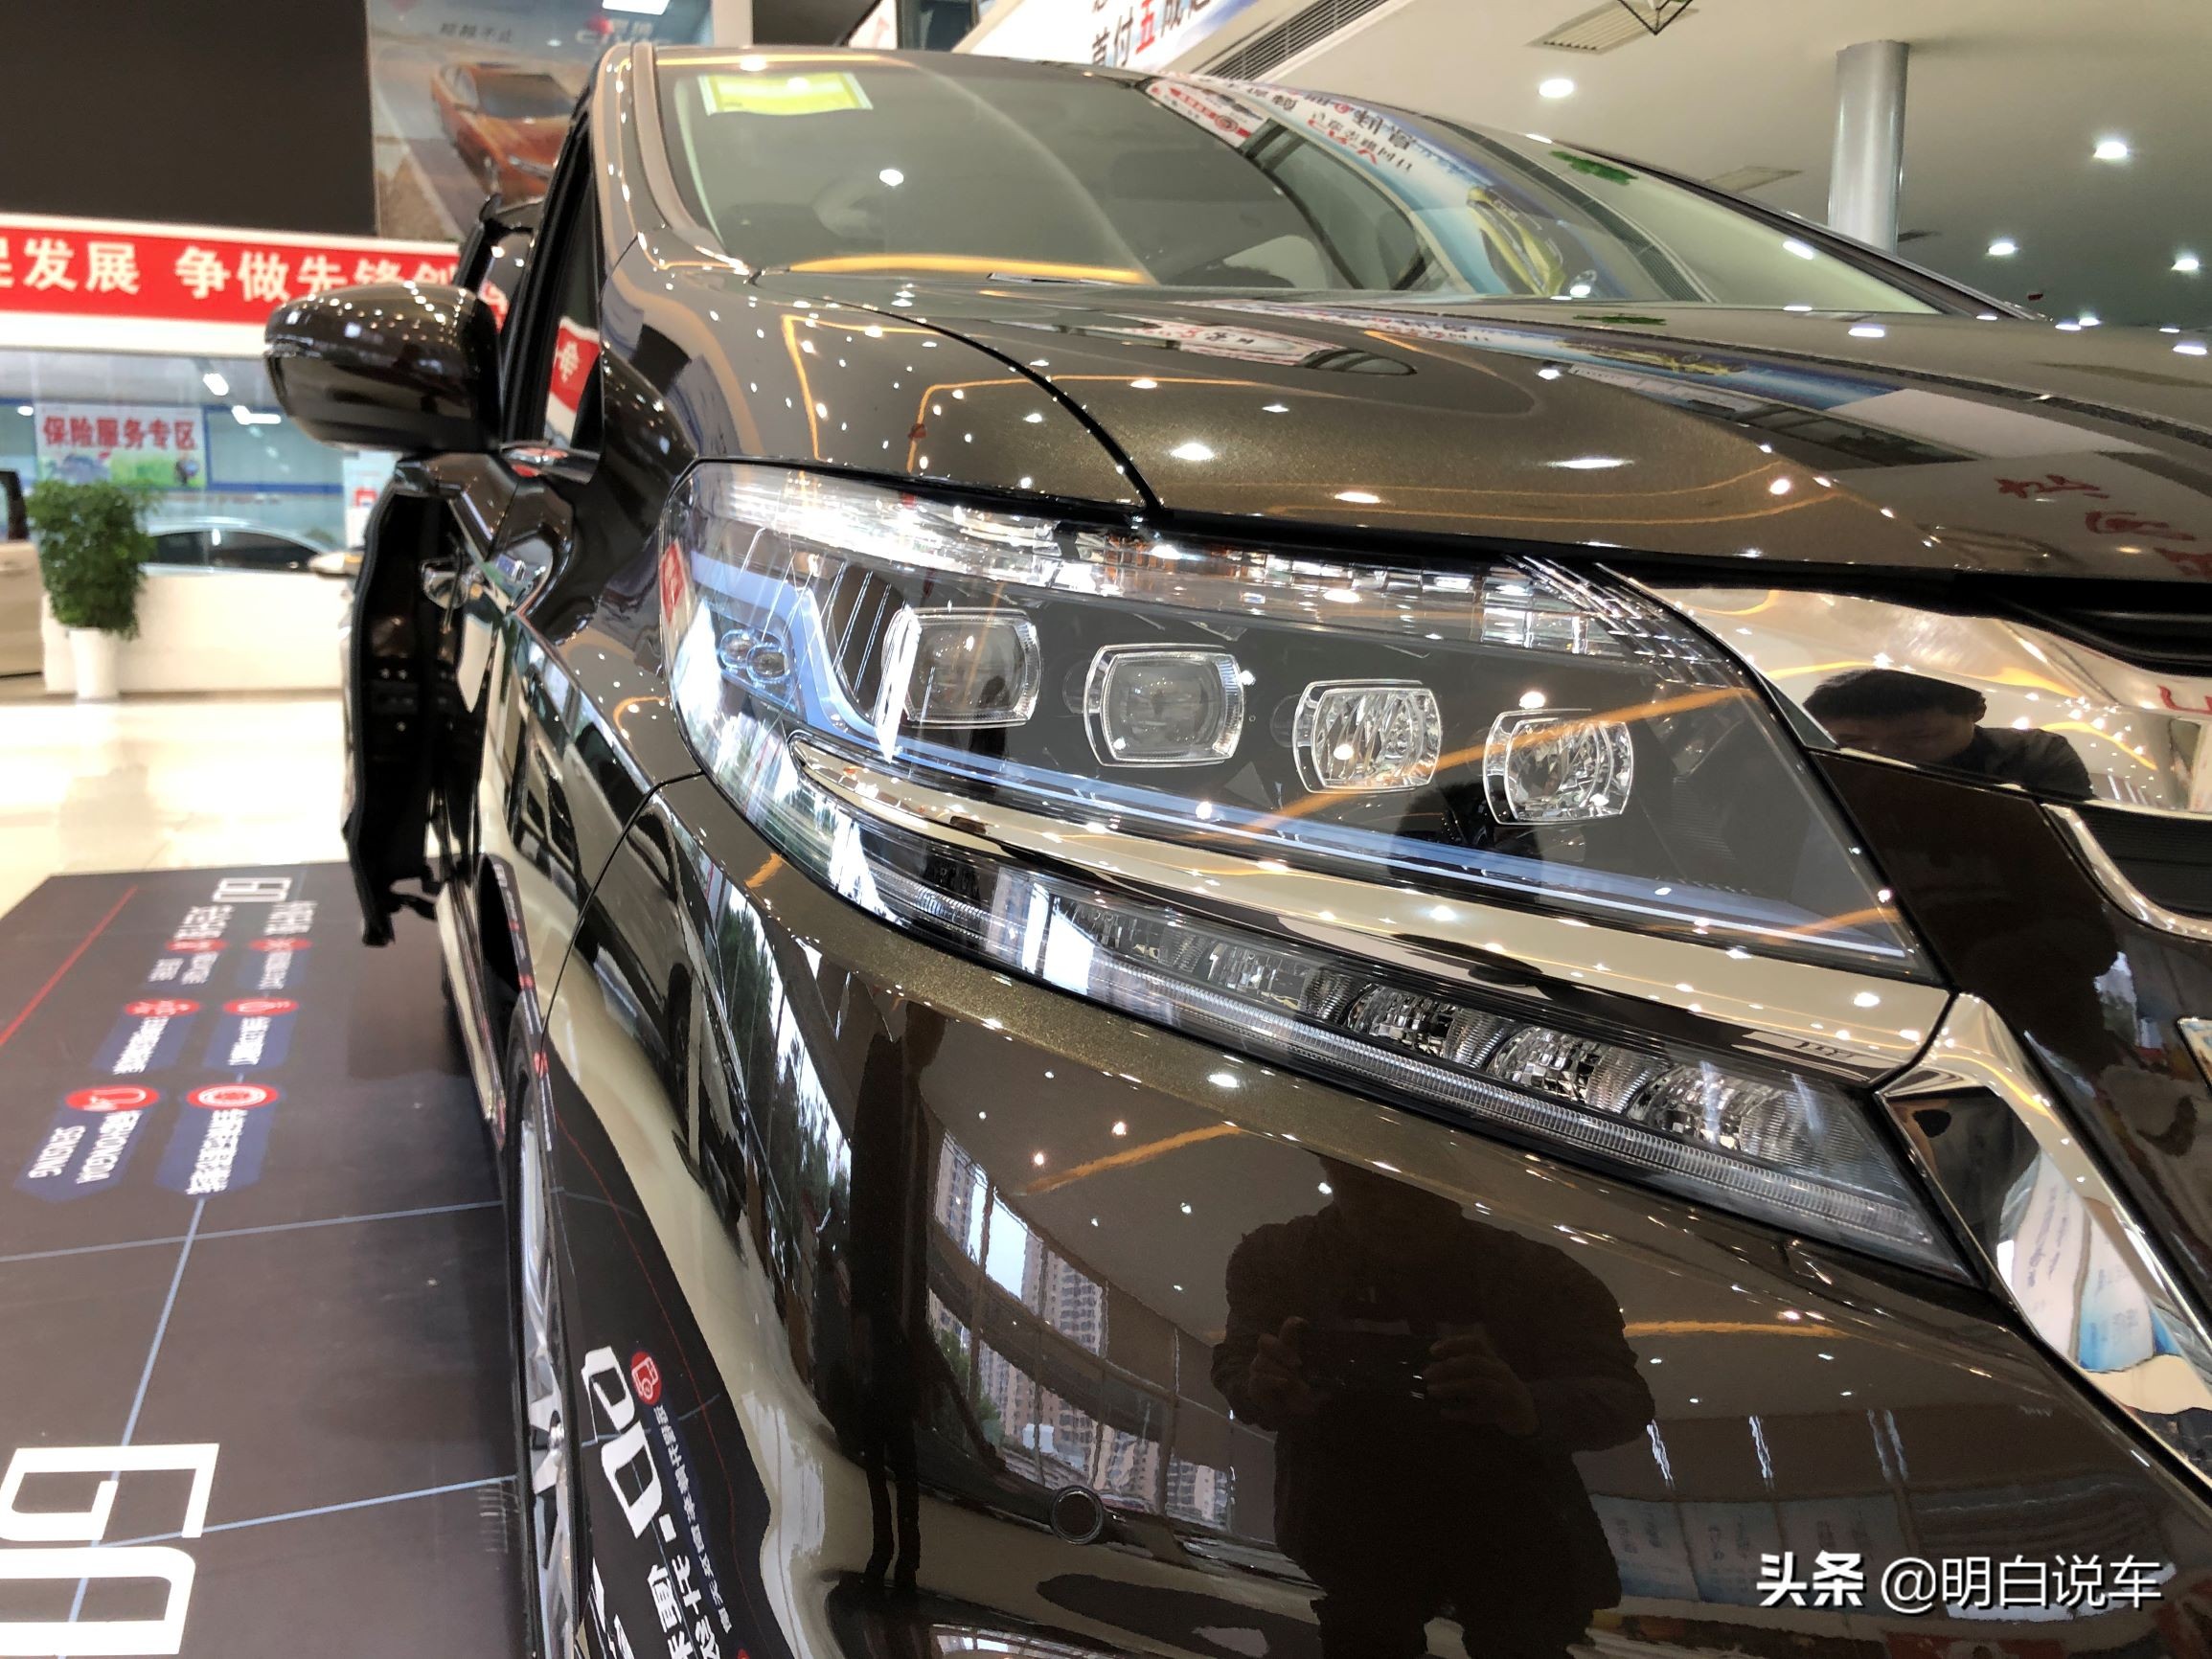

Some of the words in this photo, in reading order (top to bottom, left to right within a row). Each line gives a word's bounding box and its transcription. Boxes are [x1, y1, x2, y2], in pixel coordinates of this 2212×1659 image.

[42, 414, 197, 451] 保险服务专区
